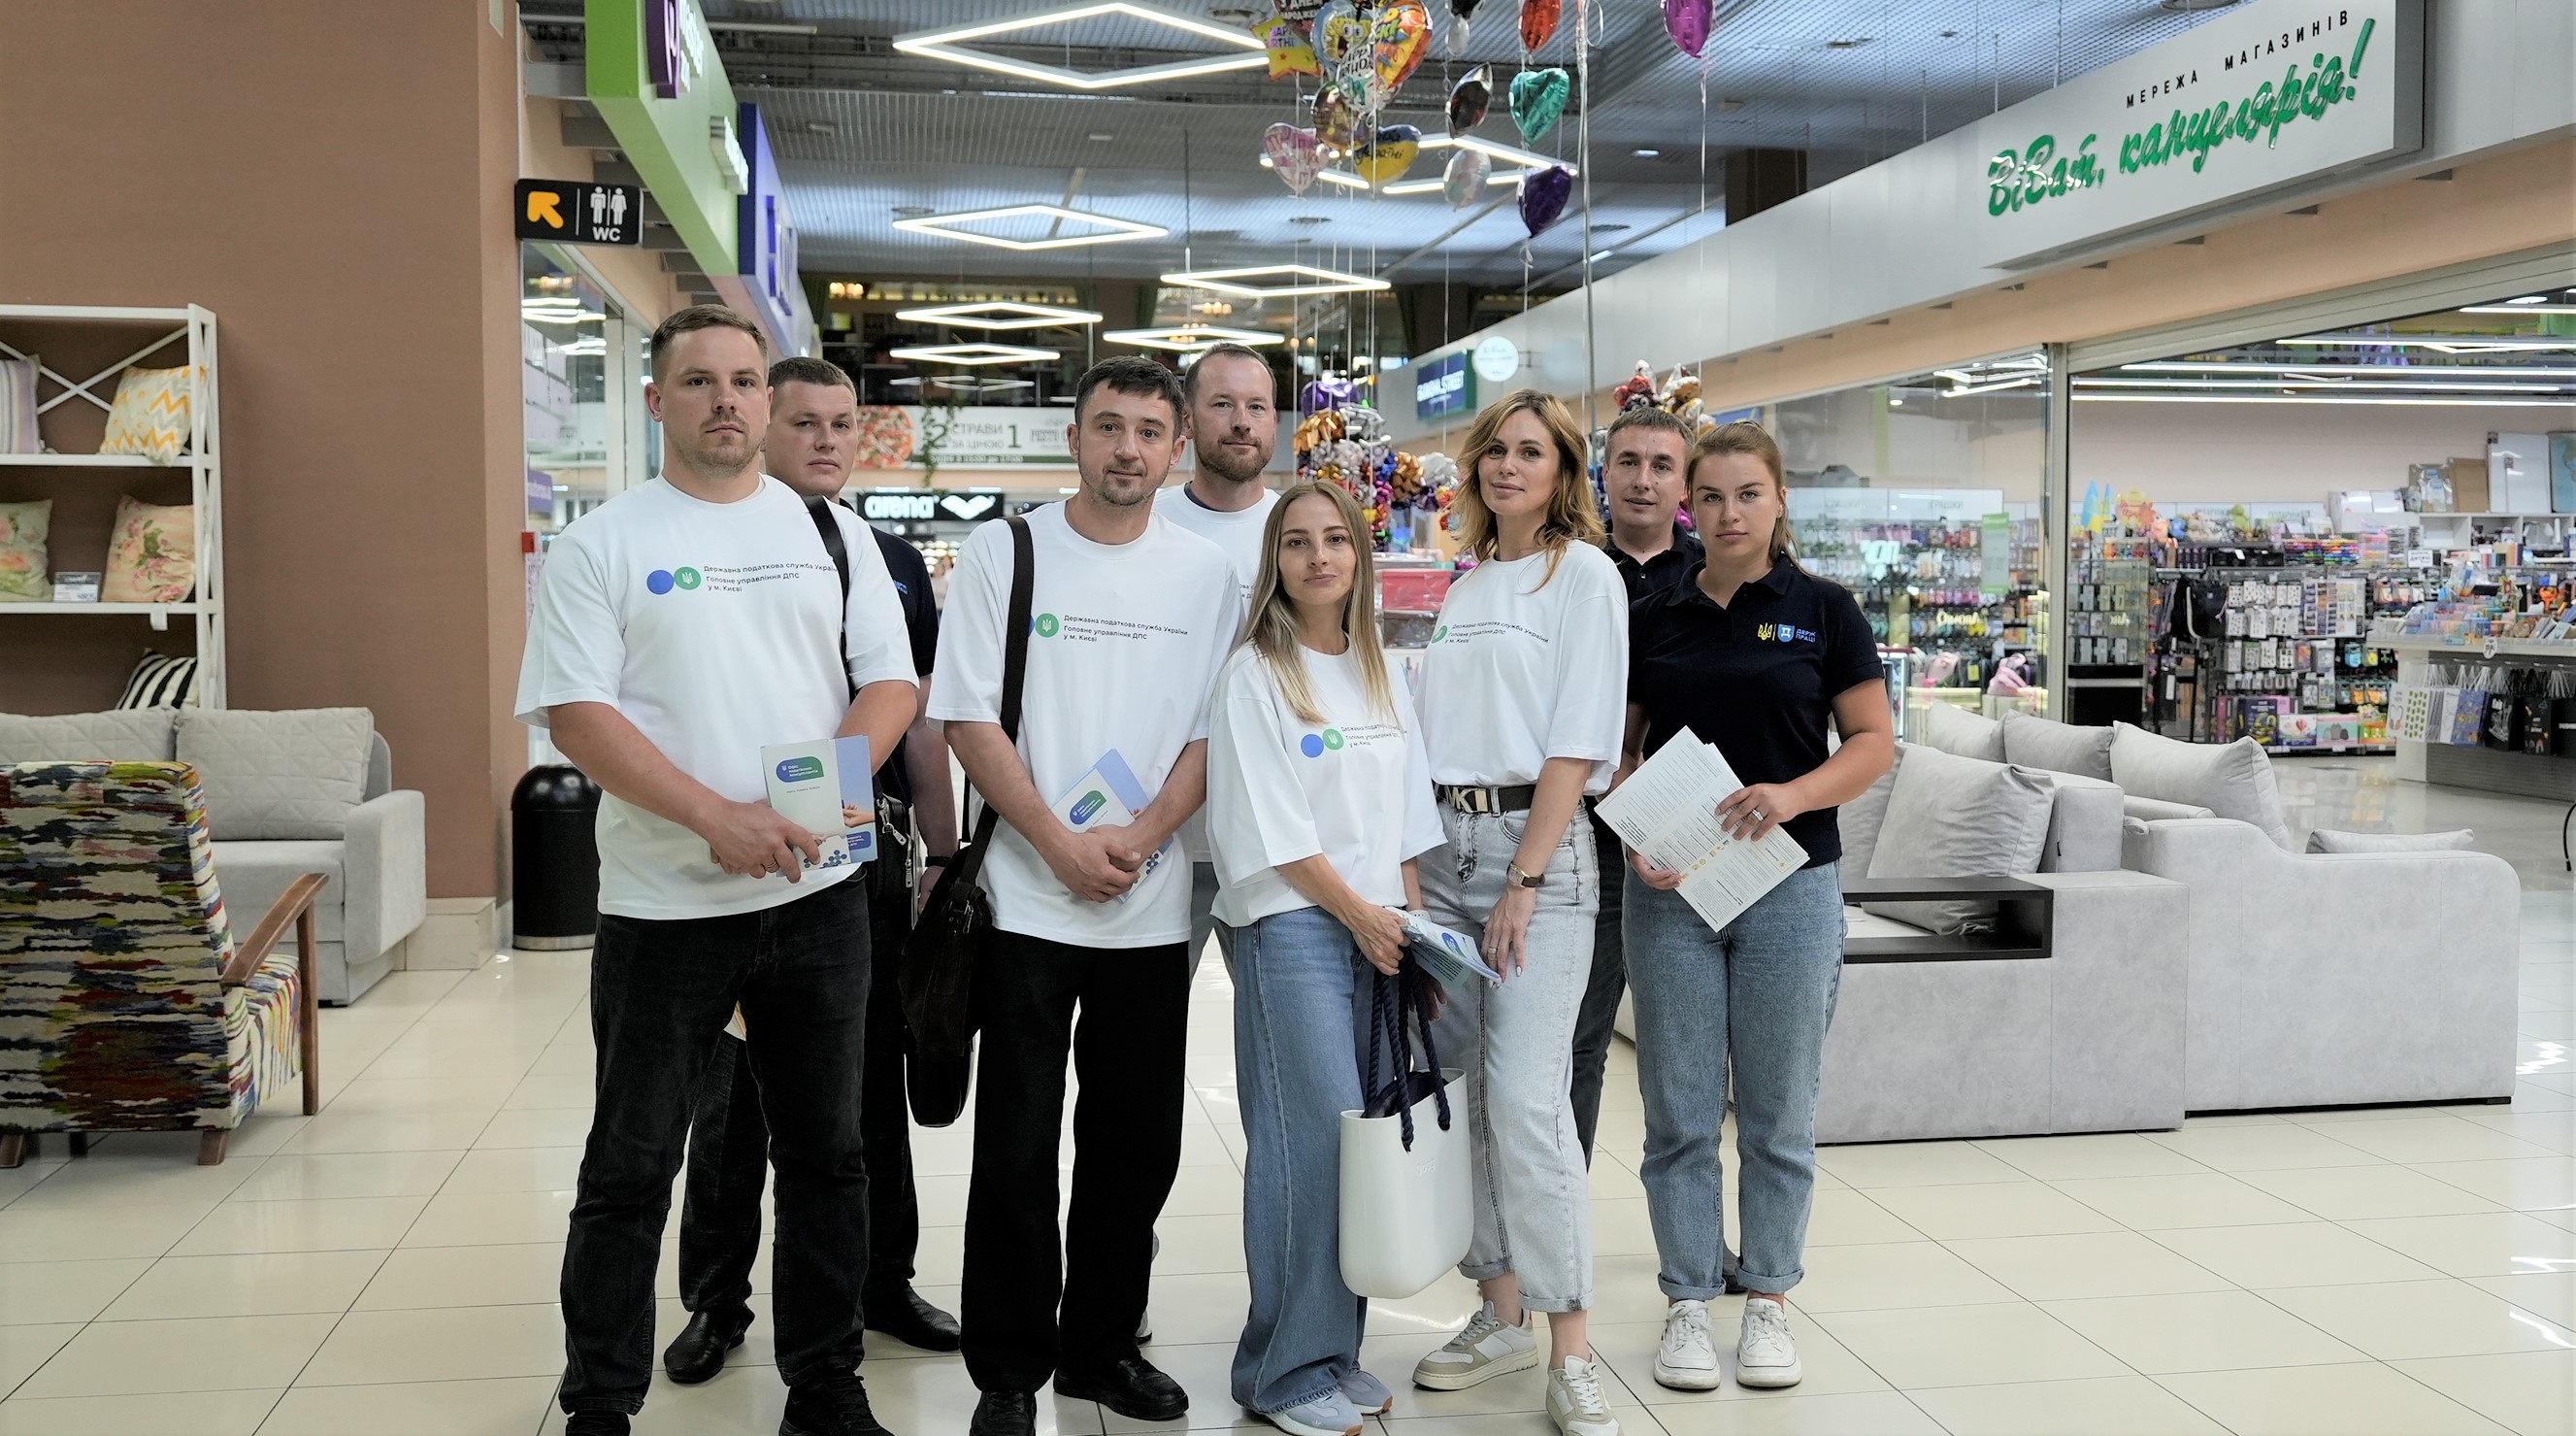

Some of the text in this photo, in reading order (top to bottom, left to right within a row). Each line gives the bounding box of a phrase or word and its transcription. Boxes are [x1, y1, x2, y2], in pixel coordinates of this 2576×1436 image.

[2127, 11, 2348, 108] МЕРЕЖА МАГАЗИНІВ
[2119, 17, 2375, 173] канцелярія!
[592, 226, 621, 242] WC
[932, 424, 948, 449] 2
[952, 423, 1004, 435] СТРАВИ
[1008, 424, 1022, 449] 1
[968, 441, 1006, 451] ЦІНОЮ
[864, 495, 935, 518] arena
[704, 565, 742, 574] Державна
[743, 563, 784, 573] податкова
[706, 576, 736, 584] Головне
[737, 574, 781, 584] управління
[1064, 615, 1188, 636] Державна податкова служба України
[1064, 625, 1093, 634] Головне
[1093, 629, 1132, 638] управління
[1078, 634, 1098, 643] Києві
